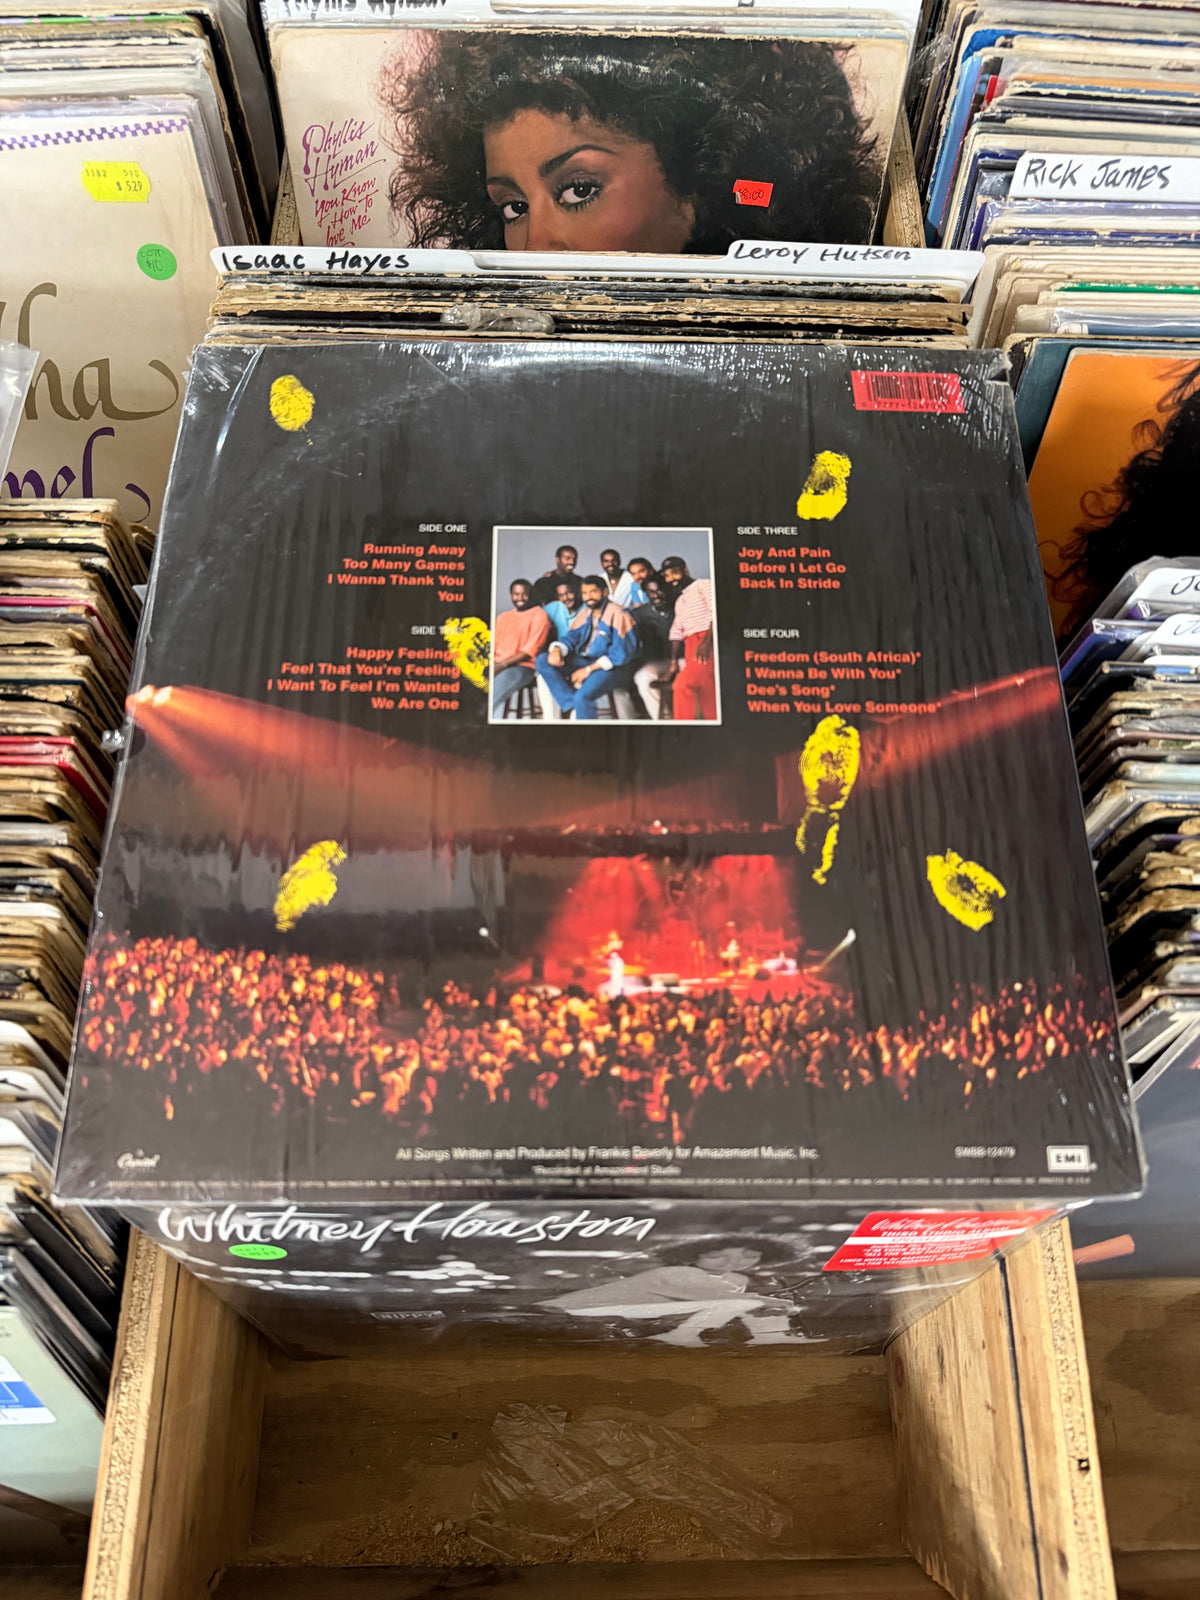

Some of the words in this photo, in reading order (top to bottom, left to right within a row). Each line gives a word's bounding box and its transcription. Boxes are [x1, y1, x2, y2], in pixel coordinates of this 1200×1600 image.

[302, 118, 375, 175] Phyllis
[304, 141, 386, 197] Hyman
[1023, 158, 1083, 189] Rick
[1090, 158, 1172, 191] James
[315, 197, 340, 228] You
[341, 177, 376, 206] Know
[330, 205, 359, 229] How
[358, 189, 379, 213] To
[350, 214, 372, 235] Me
[733, 242, 809, 264] Leroy
[222, 251, 306, 271] Isaac
[325, 250, 410, 274] Hayes
[418, 524, 442, 533] SIDE
[444, 524, 467, 533] ONE
[737, 526, 761, 535] SIDE
[763, 526, 798, 535] THREE
[363, 543, 424, 557] Running
[428, 545, 466, 558] Away
[738, 547, 763, 560] Joy
[767, 547, 796, 558] And
[800, 547, 831, 558] Pain
[342, 558, 368, 569] Too
[371, 558, 411, 572] Many
[415, 559, 465, 571] Games
[738, 562, 786, 573] Before
[790, 562, 795, 573] I
[798, 562, 822, 573] Let
[825, 562, 846, 573] Go
[327, 573, 333, 584] I
[337, 574, 385, 585] Wanna
[389, 574, 434, 586] Thank
[438, 575, 464, 586] You
[739, 578, 776, 589] Back
[779, 578, 794, 588] In
[797, 578, 841, 589] Stride
[437, 591, 464, 602] You
[411, 626, 436, 635] SIDE
[743, 629, 767, 638] SIDE
[770, 629, 800, 638] FOUR
[346, 647, 394, 661] Happy
[398, 647, 460, 662] Feelings
[744, 651, 809, 663] Freedom
[813, 651, 862, 665] (South
[281, 662, 313, 674] Feel
[317, 663, 351, 674] That
[355, 663, 402, 675] You're
[405, 664, 461, 679] Feeling
[745, 667, 751, 679] I
[754, 667, 804, 679] Wanna
[807, 667, 828, 679] Be
[830, 667, 865, 680] With
[267, 679, 273, 690] I
[277, 679, 315, 691] Want
[319, 680, 336, 692] To
[340, 680, 373, 692] Feel
[376, 680, 400, 692] I'm
[403, 681, 460, 693] Wanted
[746, 683, 787, 696] Dee's
[371, 697, 394, 710] We
[398, 698, 424, 710] Are
[428, 698, 459, 710] One
[747, 700, 790, 713] When
[793, 700, 821, 713] You
[825, 701, 861, 713] Love
[396, 1147, 412, 1160] All
[414, 1147, 450, 1163] Songs
[451, 1146, 492, 1160] Written
[494, 1147, 516, 1160] and
[517, 1146, 570, 1160] Produced
[572, 1147, 587, 1162] by
[675, 1146, 691, 1160] for
[692, 1146, 759, 1160] Amazement
[1055, 1152, 1081, 1163] EMI
[158, 1204, 394, 1253] Whitney
[392, 1201, 656, 1244] Houston
